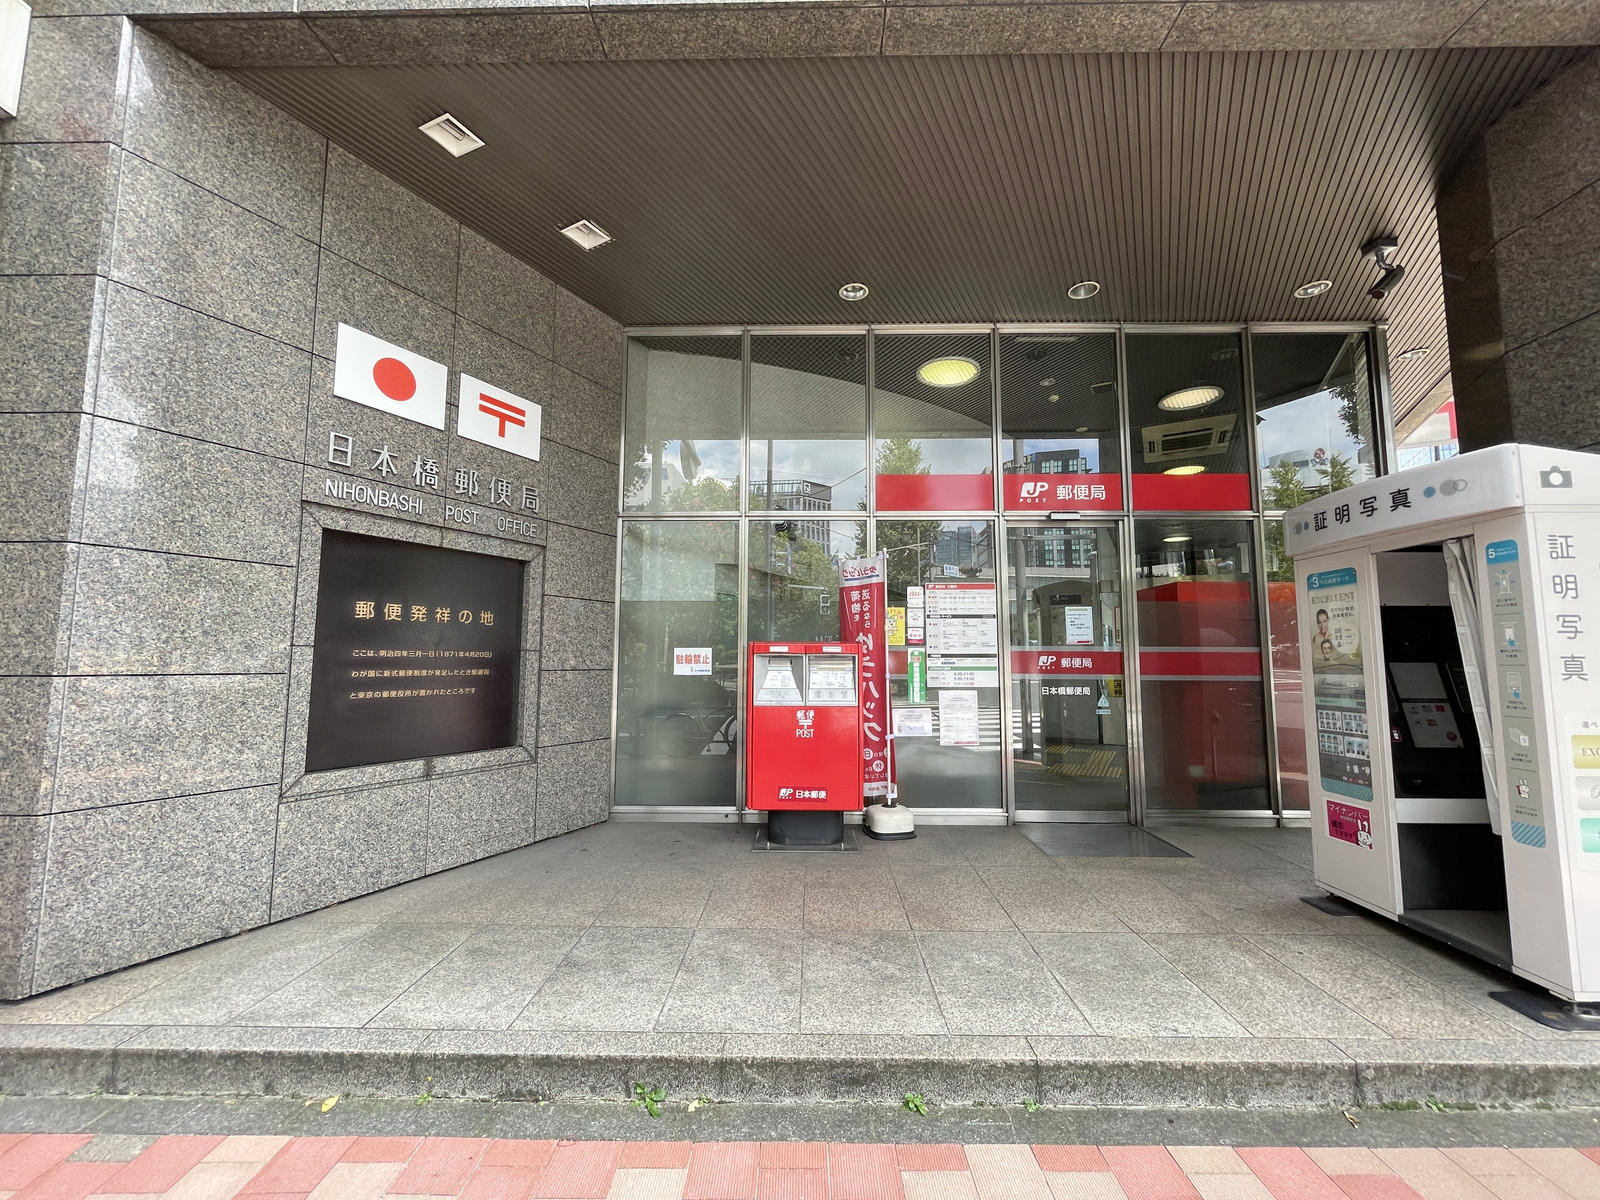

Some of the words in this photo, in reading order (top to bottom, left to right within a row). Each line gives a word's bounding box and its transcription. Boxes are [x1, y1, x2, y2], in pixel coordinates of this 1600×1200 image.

[328, 431, 540, 513] 日本橋郵便局
[1056, 484, 1106, 501] 郵便局
[325, 478, 423, 515] NIHONBASHI
[445, 505, 479, 525] POST
[497, 516, 538, 538] OFFICE
[1313, 487, 1412, 532] 証明写真
[1312, 591, 1355, 605] EXCELLENT
[354, 601, 494, 626] 郵便発祥の地
[1547, 534, 1588, 682] 証明写真
[676, 653, 711, 665] 駐輪禁止
[1060, 657, 1093, 669] 郵便局
[1041, 686, 1091, 696] 日本橋郵便局
[796, 709, 815, 720] 郵便
[796, 728, 815, 738] POST
[795, 790, 827, 799] 日本郵便
[1327, 803, 1369, 819] マイナンバー
